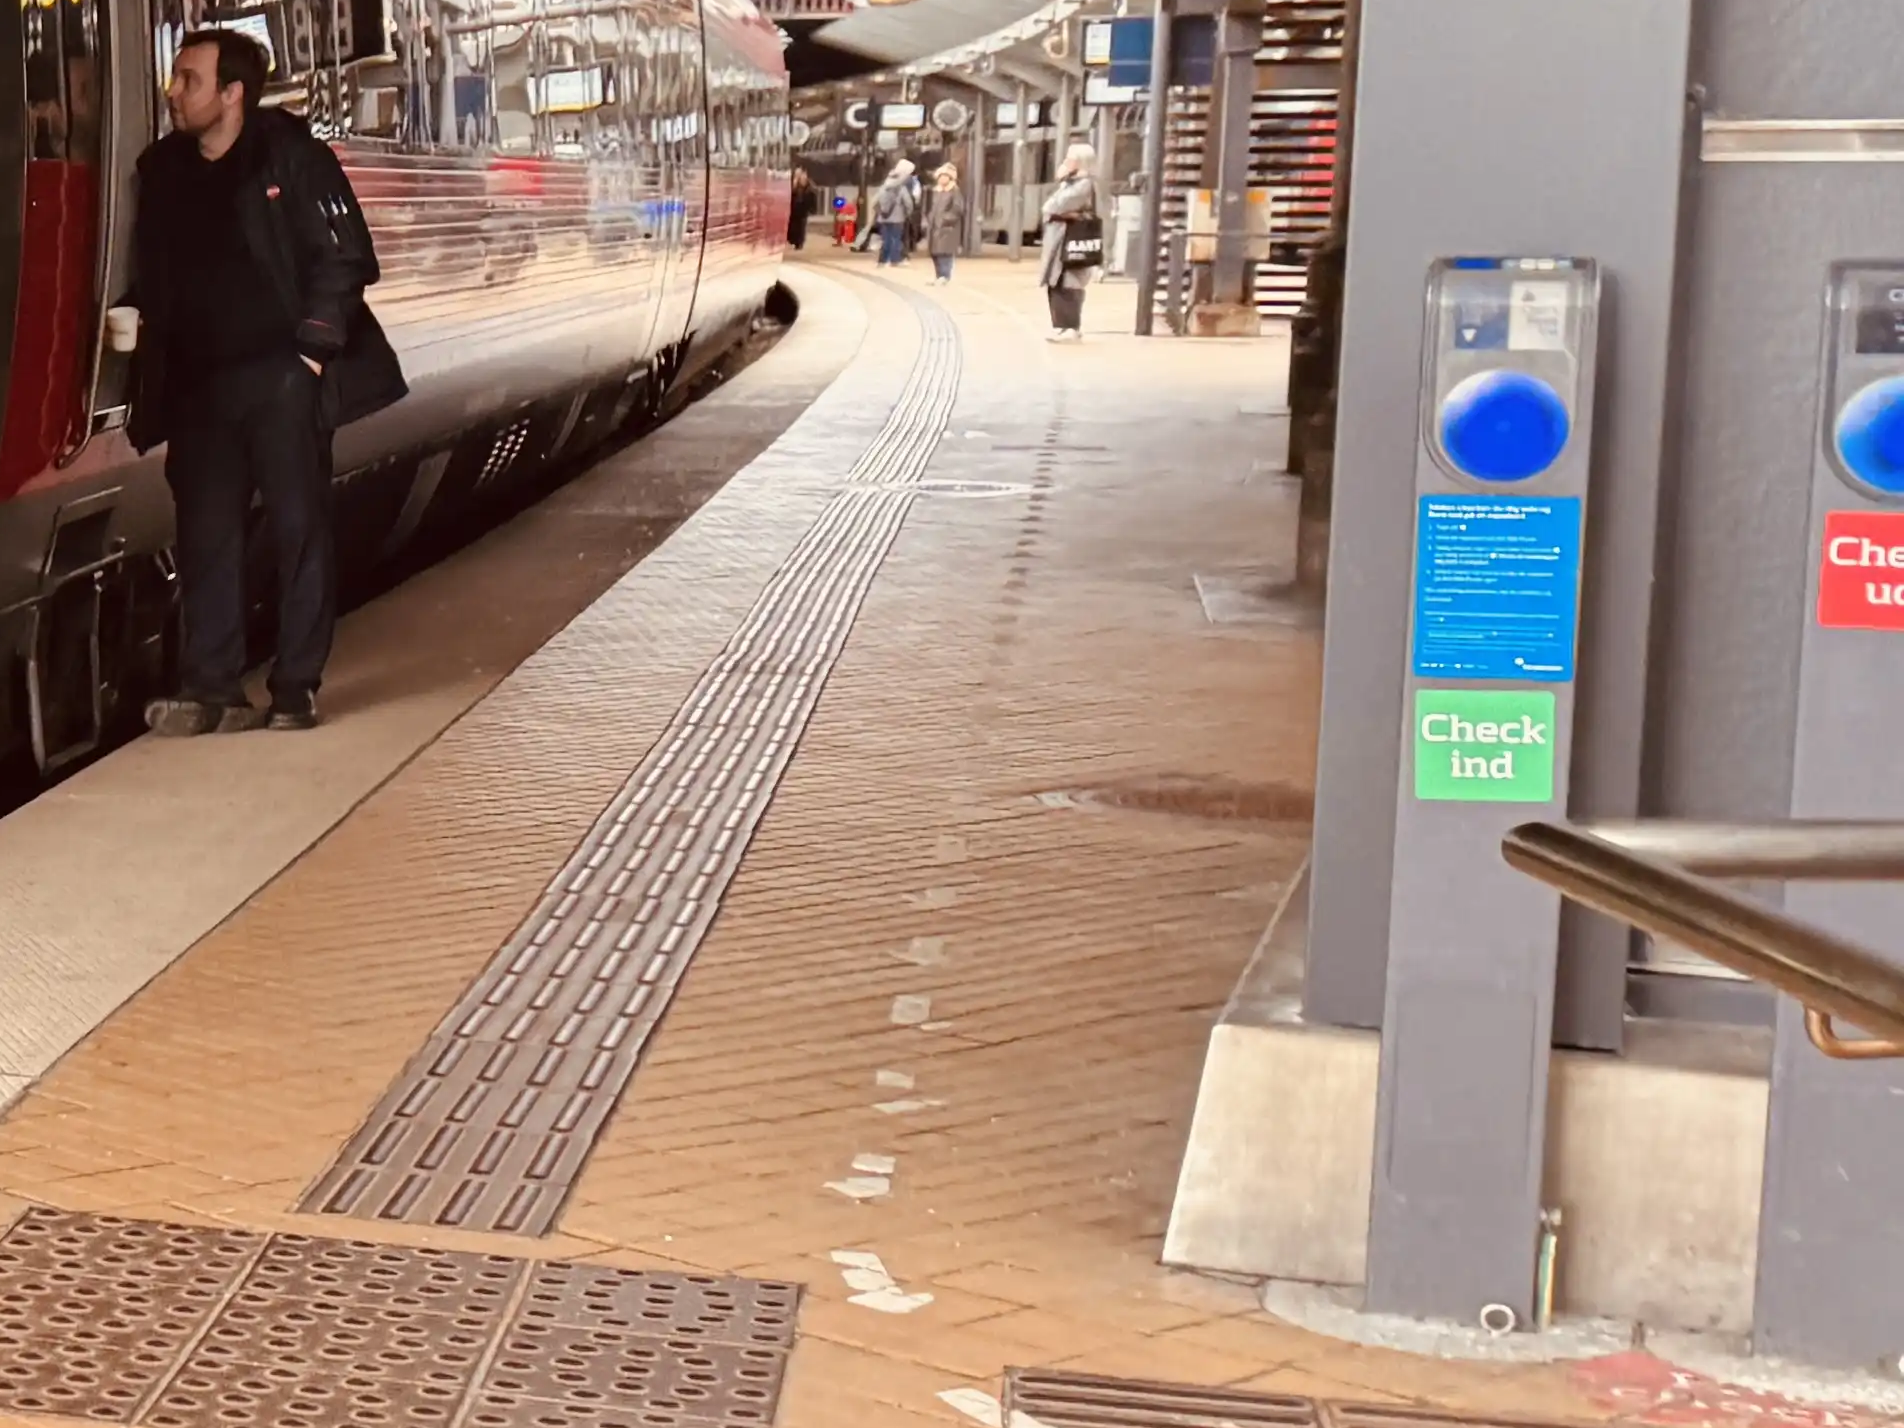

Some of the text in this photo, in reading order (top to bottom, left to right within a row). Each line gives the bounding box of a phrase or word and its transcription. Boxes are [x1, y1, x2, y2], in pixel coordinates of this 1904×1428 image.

[845, 102, 869, 129] C
[1421, 713, 1547, 744] Check
[1450, 749, 1515, 779] ind
